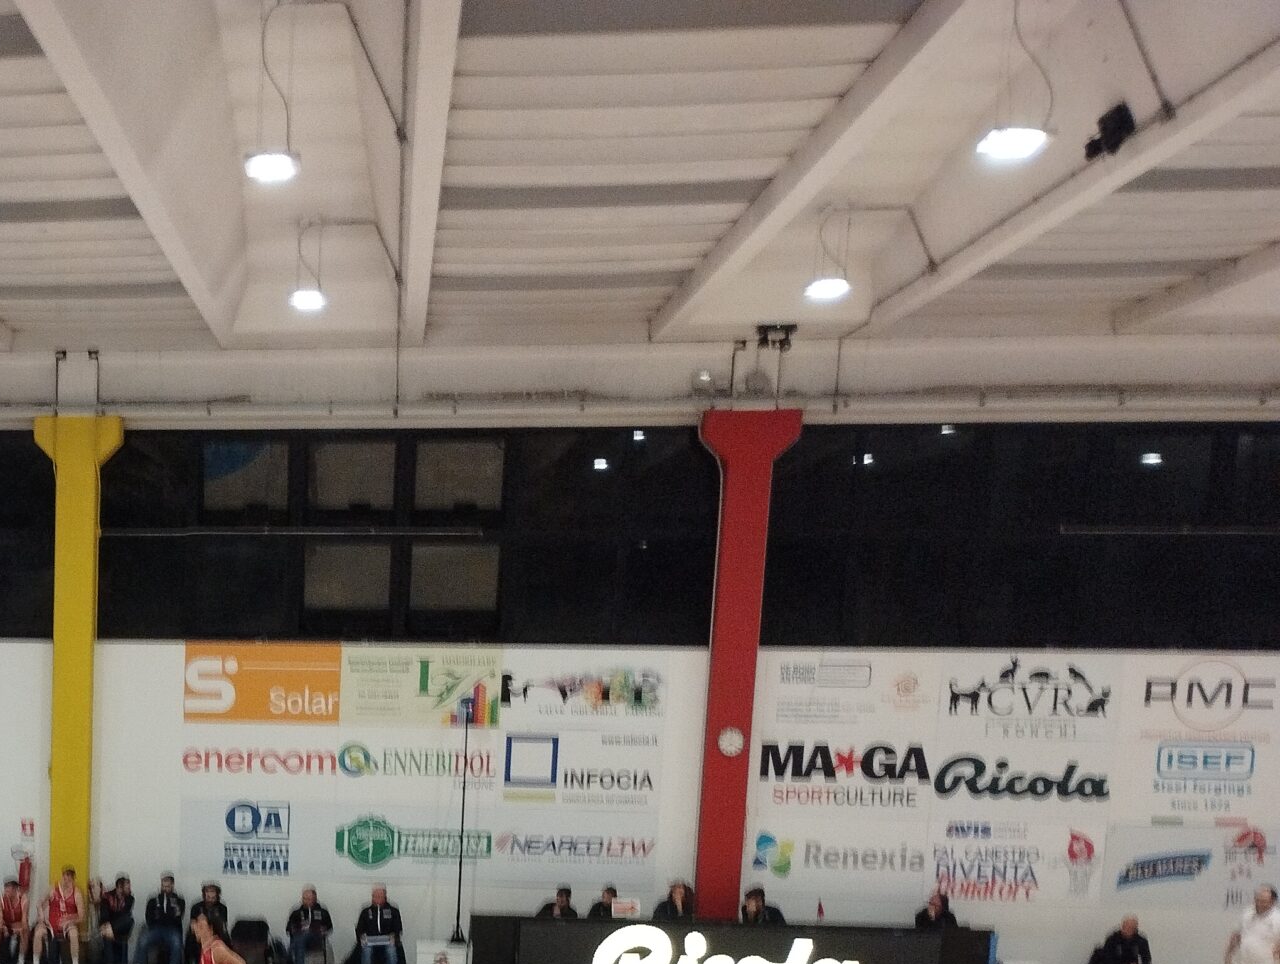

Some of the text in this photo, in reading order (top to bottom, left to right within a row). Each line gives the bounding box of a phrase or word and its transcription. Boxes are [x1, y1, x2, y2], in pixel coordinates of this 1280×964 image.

[268, 685, 341, 717] Solar
[934, 752, 1111, 802] Ricola
[804, 837, 926, 873] Renexia
